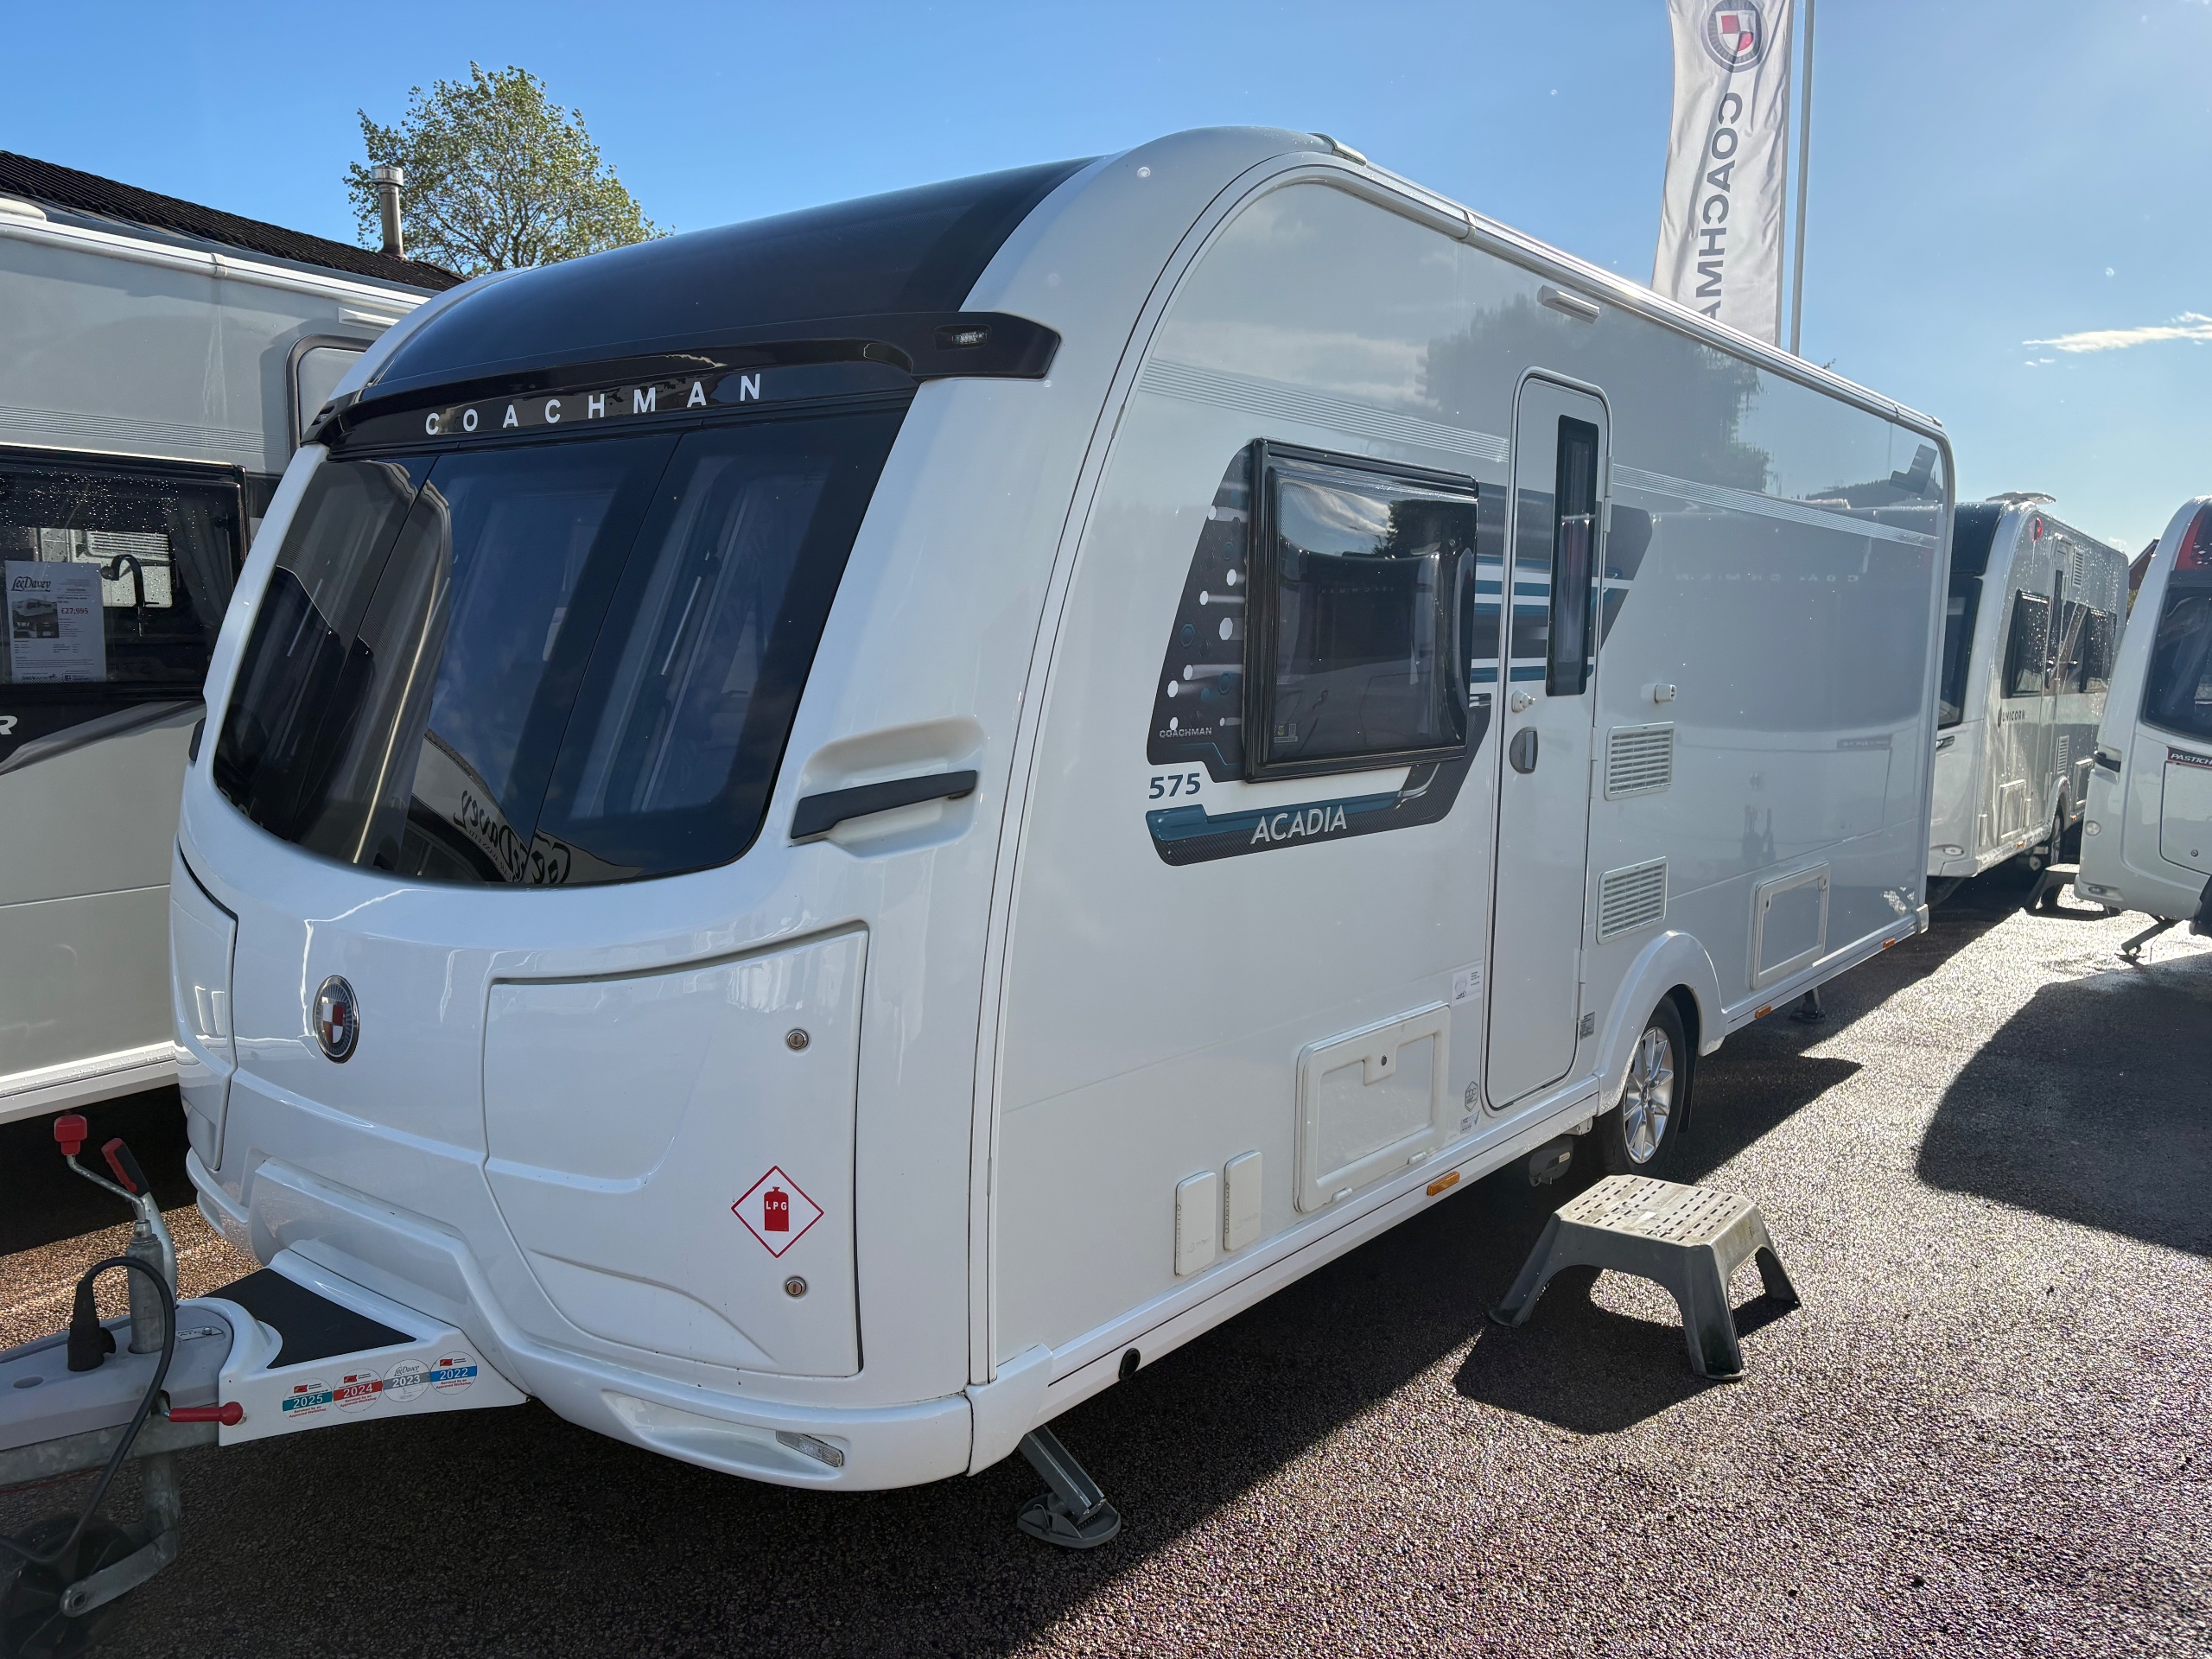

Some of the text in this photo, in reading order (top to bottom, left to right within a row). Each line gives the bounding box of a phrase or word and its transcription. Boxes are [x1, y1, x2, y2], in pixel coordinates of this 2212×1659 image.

[425, 372, 761, 435] COACHMAN
[1159, 727, 1212, 739] COACHMAN
[1148, 772, 1201, 799] 575
[1249, 804, 1347, 845] ACADIA
[766, 1200, 787, 1211] LPG
[440, 1368, 468, 1380] 2022
[392, 1375, 421, 1388] 2023
[343, 1383, 372, 1398] 2024
[293, 1394, 323, 1408] 2025
